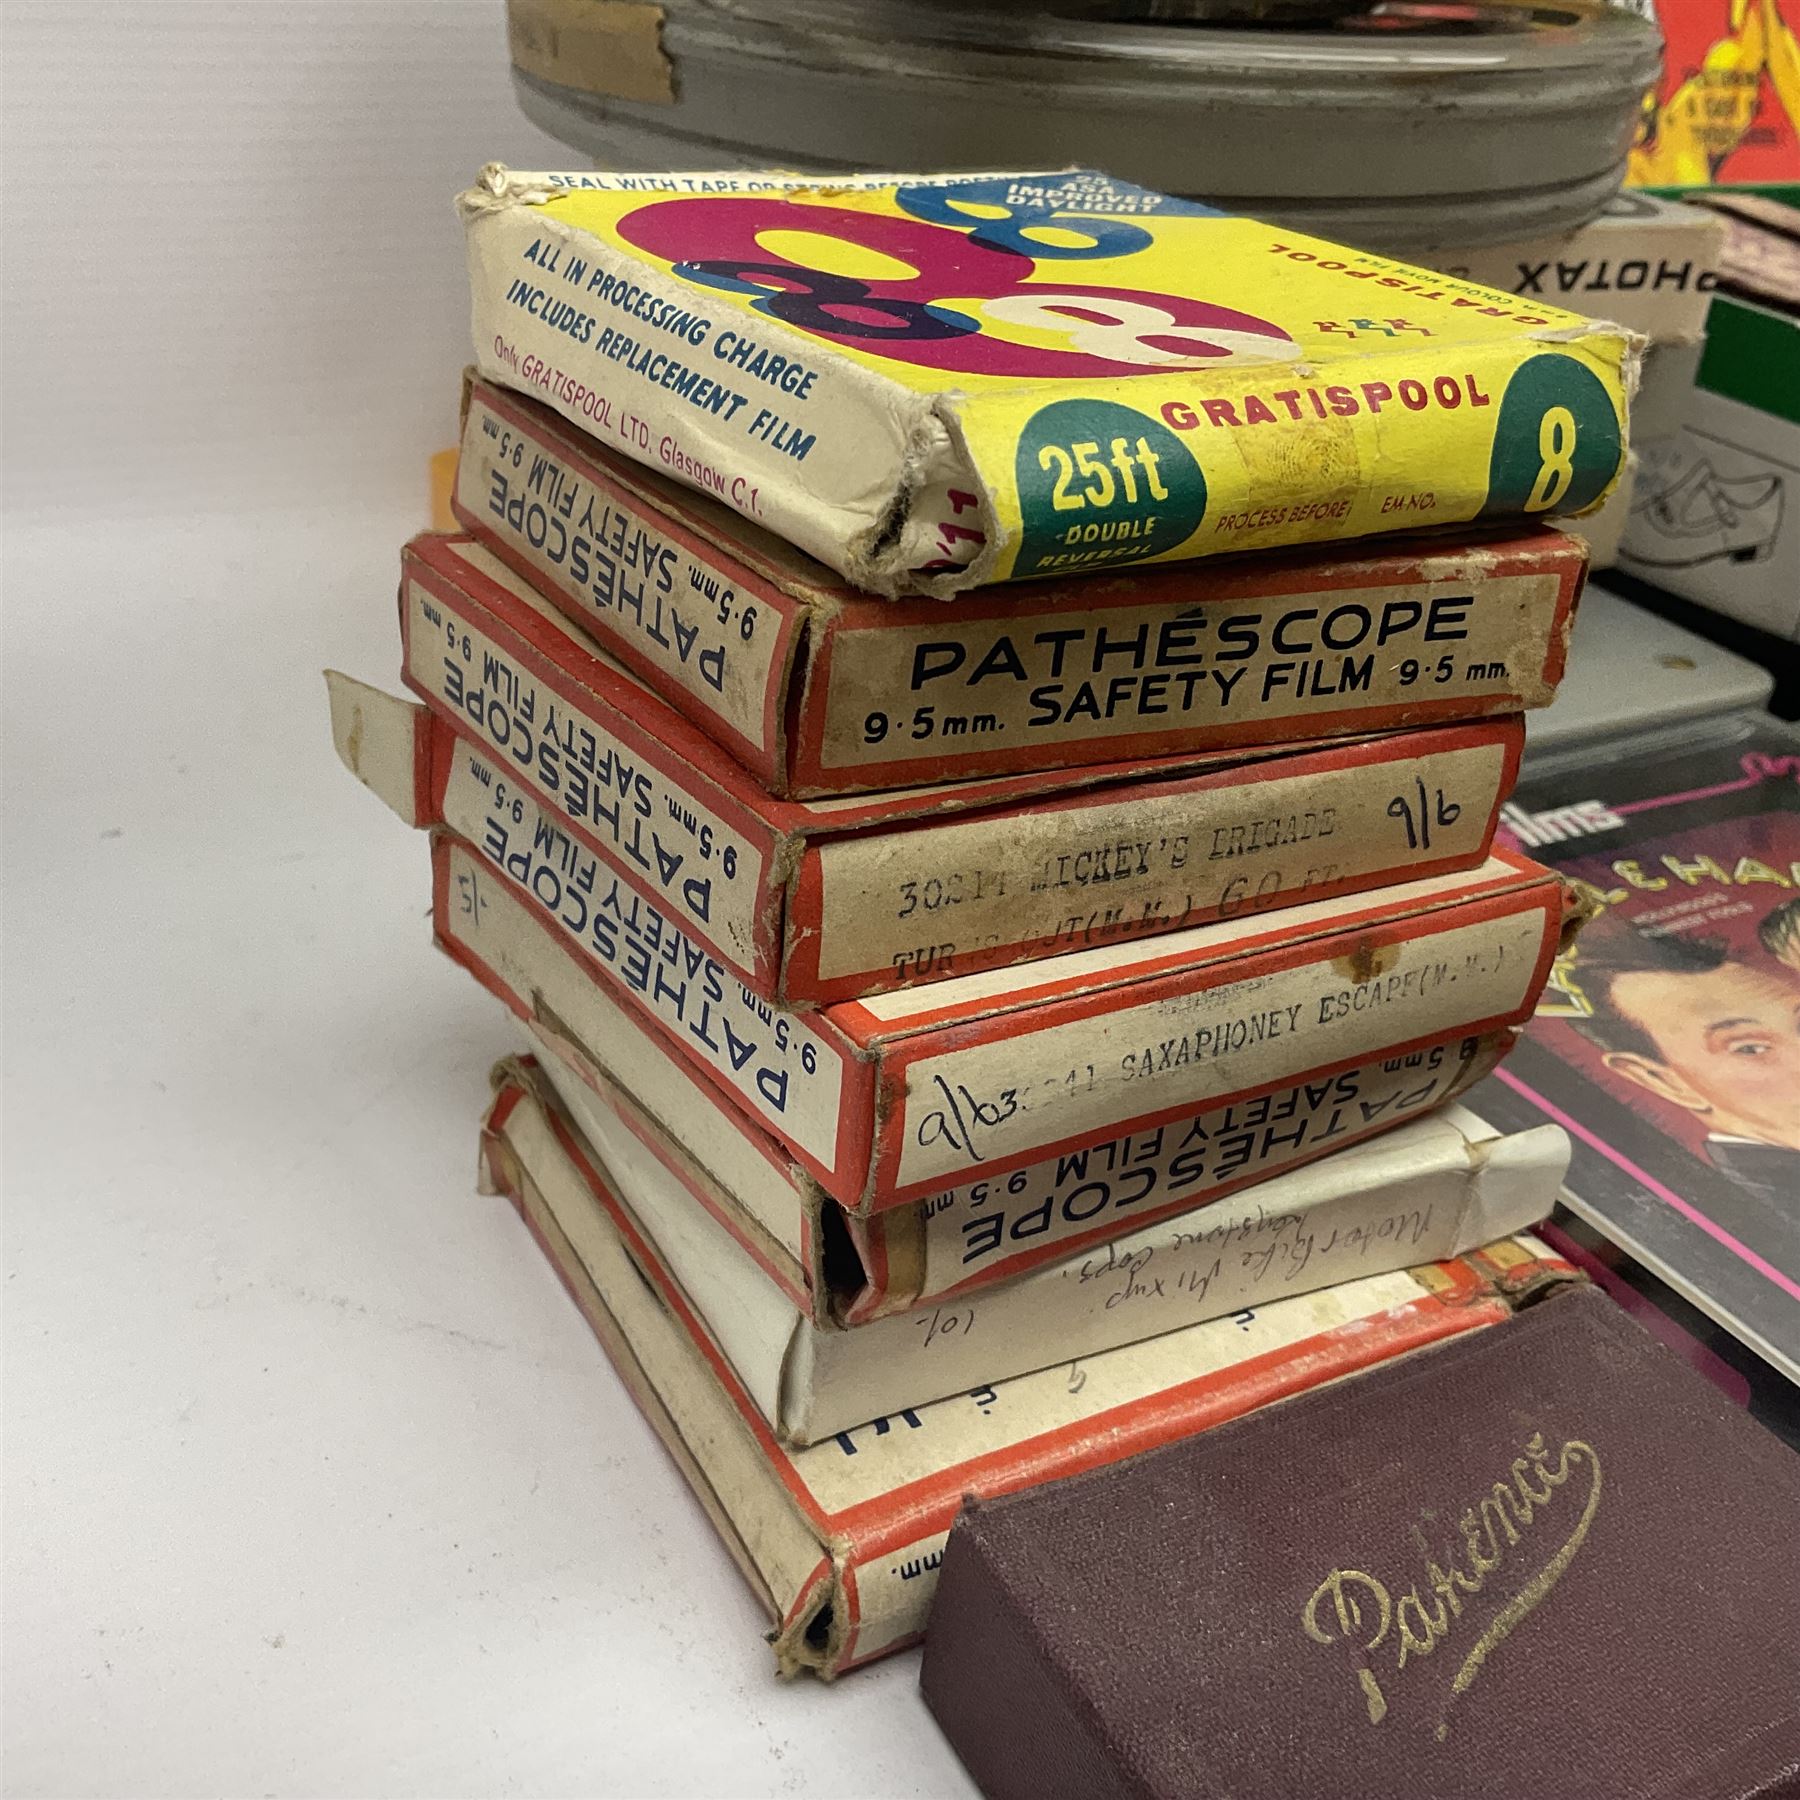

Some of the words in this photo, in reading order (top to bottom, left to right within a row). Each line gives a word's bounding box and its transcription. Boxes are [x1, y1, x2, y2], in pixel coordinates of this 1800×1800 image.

[548, 175, 611, 191] SEAL
[615, 178, 678, 192] WITH
[1005, 194, 1158, 213] DAYLIGHT
[1008, 184, 1163, 205] IMPROVED
[1060, 182, 1115, 195] ASA
[524, 238, 557, 282] ALL
[568, 254, 587, 286] IN
[592, 268, 713, 348] PROCESSING
[713, 330, 818, 400] CHARGE
[1267, 243, 1550, 326] GRATISPOOL
[506, 278, 596, 344] INCLUDES
[595, 326, 748, 423] REPLACEMENT
[750, 407, 818, 461] FILM
[1160, 373, 1492, 432] GRATISPOOL
[494, 335, 520, 368] Only
[522, 353, 612, 428] GRATISPOOL
[620, 413, 654, 455] LTD.
[659, 435, 727, 496] Glasgow
[527, 453, 579, 519] FILM
[1038, 434, 1169, 512] 25ft
[1523, 406, 1578, 513] 8
[578, 495, 678, 593] SAFETY
[1063, 516, 1157, 546] DOUBLE
[1214, 507, 1286, 534] PROCESS
[1287, 500, 1349, 524] BEFORE
[489, 468, 727, 692] PATHÉSCOPE
[909, 593, 1477, 693] PATHÉSCOPE
[484, 650, 536, 724] FILM
[1026, 666, 1253, 728] SAFETY
[1259, 652, 1376, 703] FILM
[443, 656, 711, 923] PATHÉSCOPE
[542, 704, 653, 818] SAFETY
[533, 815, 597, 893] FILM
[482, 815, 790, 1114] PATHÉSCOPE
[602, 878, 726, 1003] SAFETY
[1121, 1003, 1303, 1082] SAXAPHONEY
[1178, 1068, 1362, 1142] SAFETY
[961, 1076, 1441, 1265] PATHÉSCOPE
[1055, 1126, 1165, 1179] FILM
